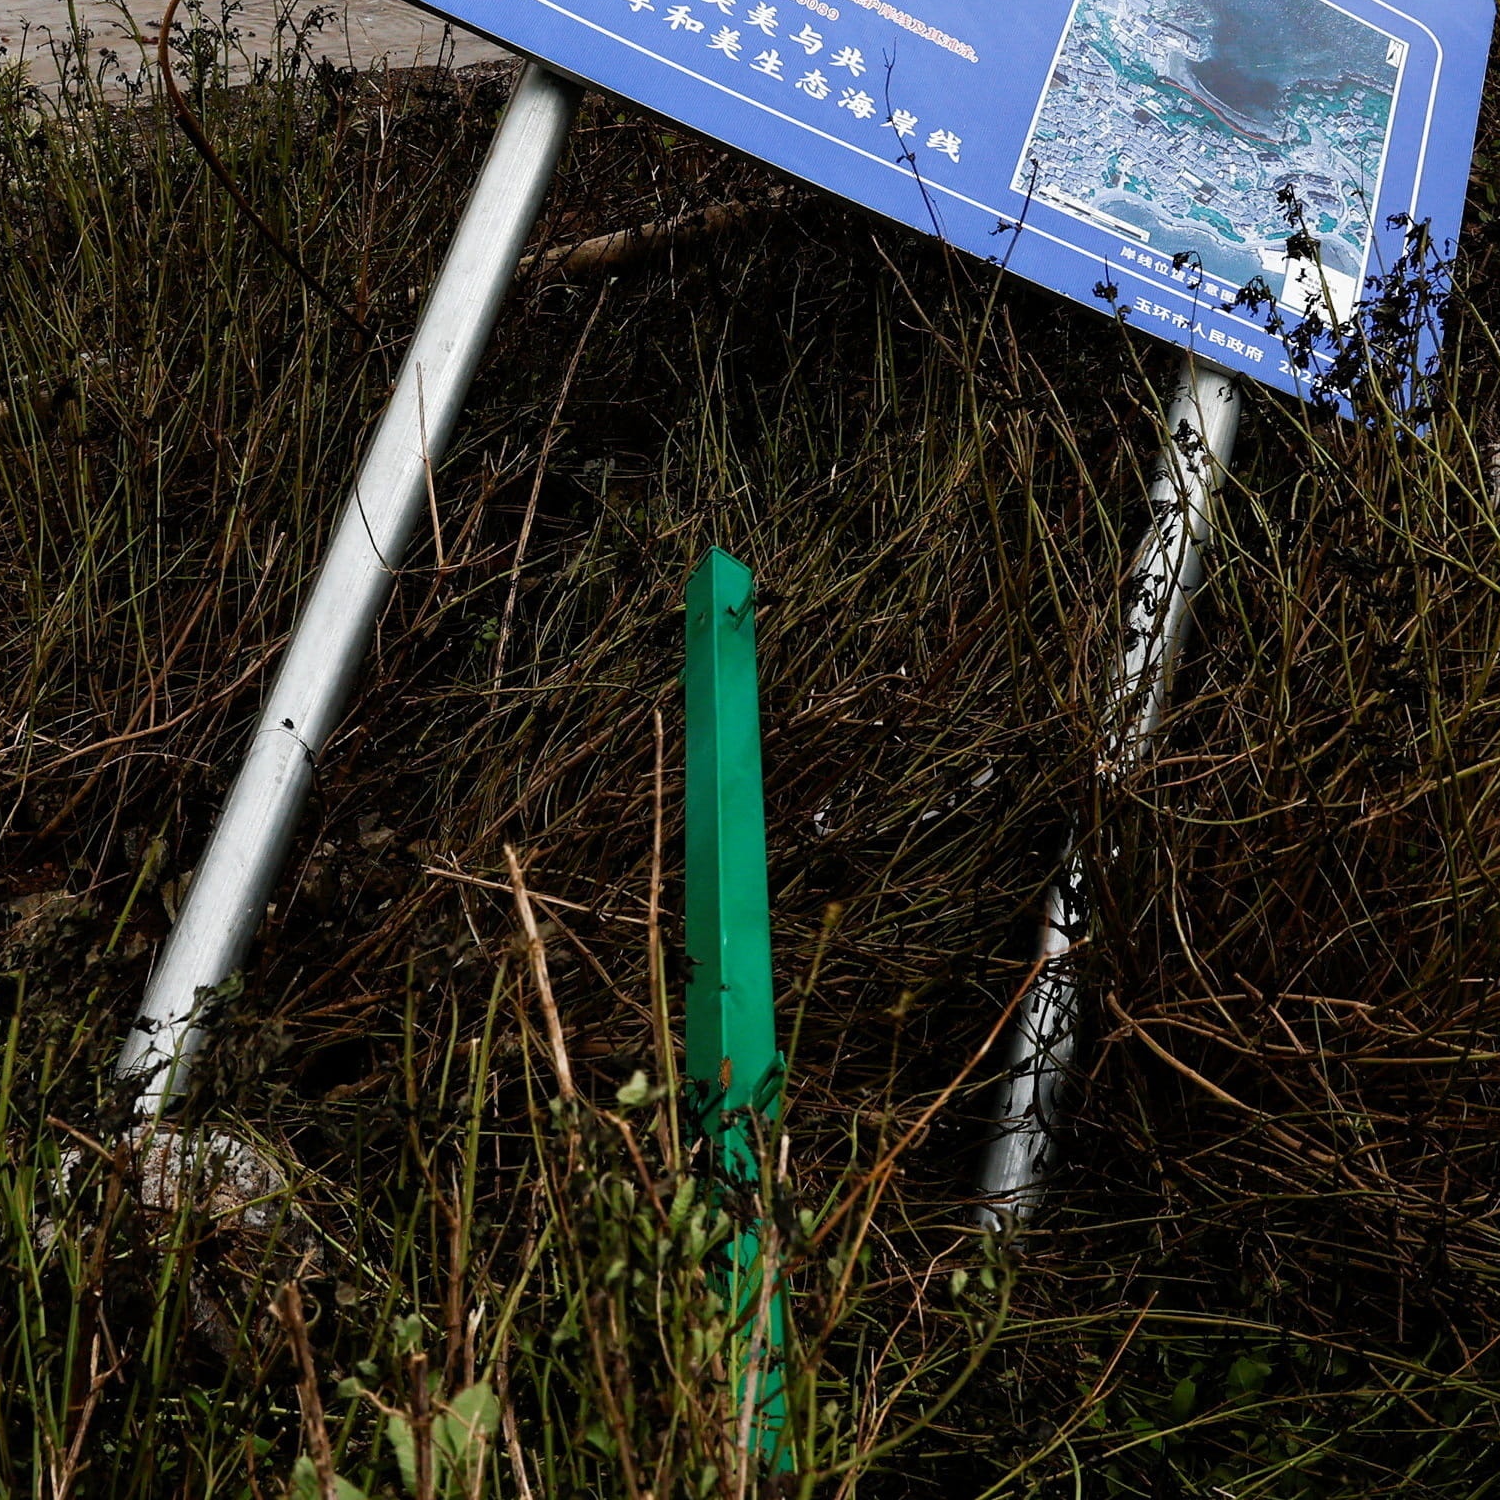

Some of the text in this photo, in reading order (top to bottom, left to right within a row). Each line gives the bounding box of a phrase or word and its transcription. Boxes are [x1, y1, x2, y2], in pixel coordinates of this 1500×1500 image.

[1133, 296, 1265, 362] 玉环市人民政府
